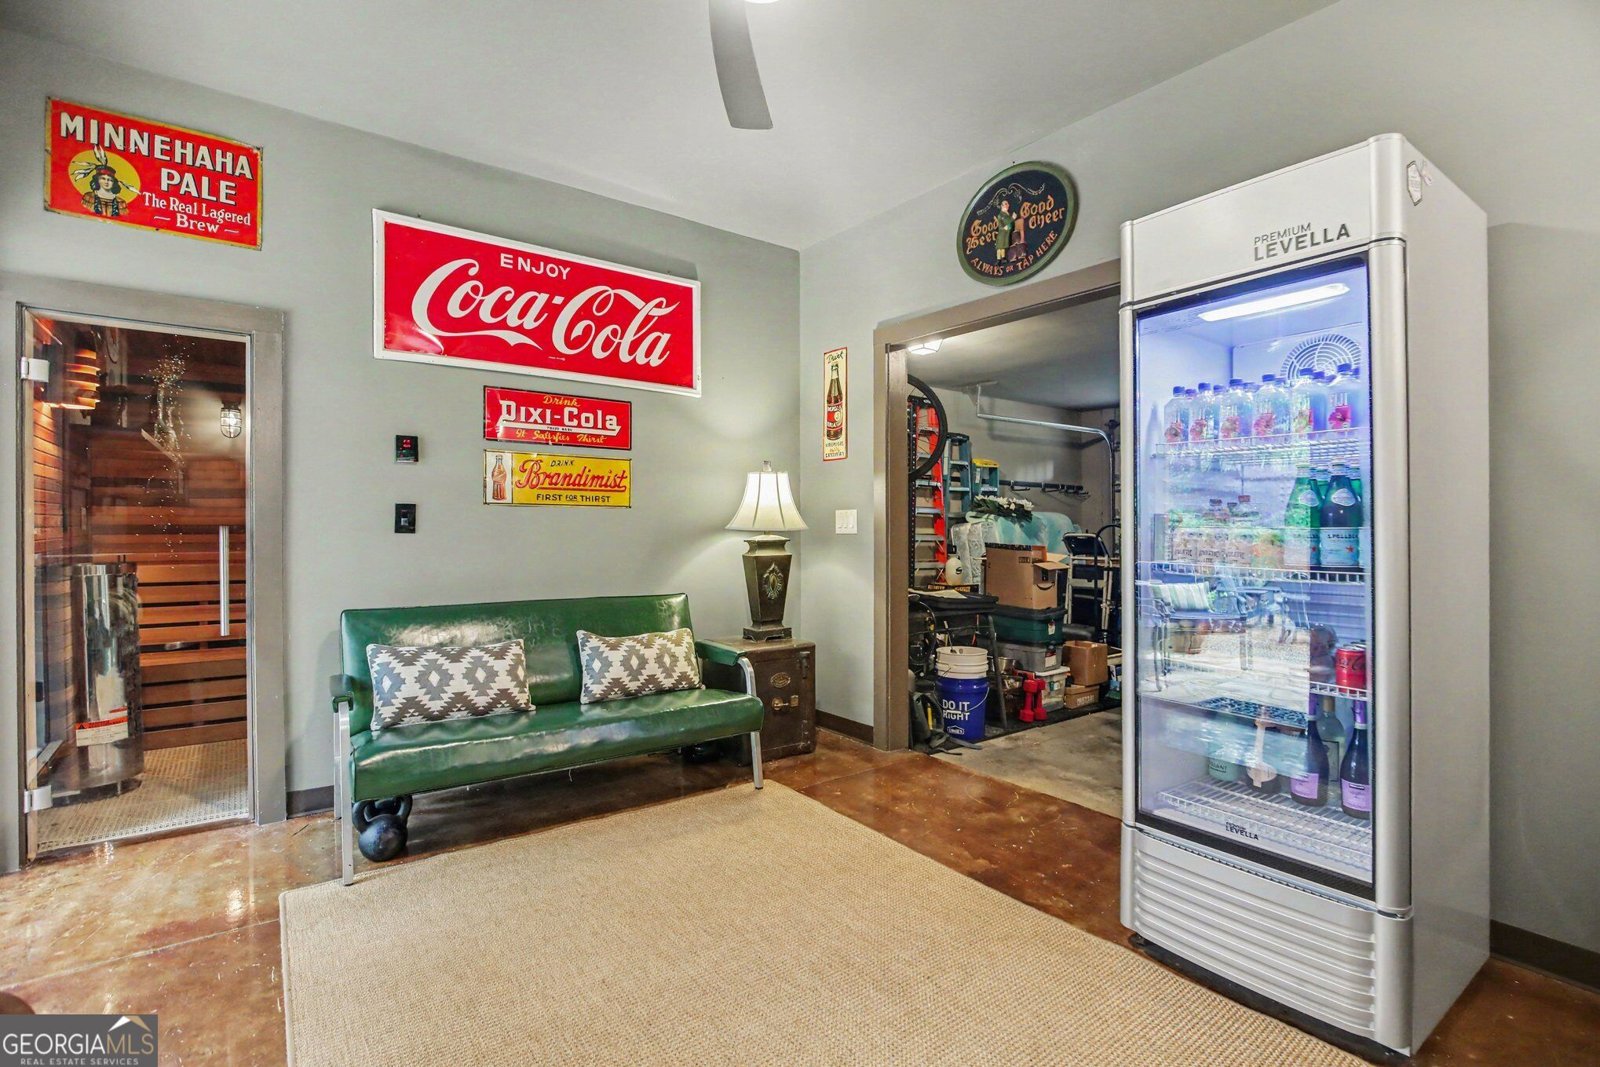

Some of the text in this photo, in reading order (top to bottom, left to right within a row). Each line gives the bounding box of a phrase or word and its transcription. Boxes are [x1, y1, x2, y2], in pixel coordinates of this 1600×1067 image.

[60, 112, 253, 179] MINNEHAHA
[160, 167, 236, 205] PALE
[142, 191, 251, 226] The Real Lagered
[1020, 194, 1055, 219] Good
[176, 213, 219, 234] Brew
[970, 215, 999, 237] Good
[1253, 222, 1312, 246] PREMIUM
[1253, 223, 1350, 262] LEVELLA
[500, 253, 571, 281] ENJOY
[970, 257, 1005, 276] ALWAYS
[1016, 254, 1034, 271] TAP
[411, 258, 680, 367] Coca-Cola
[543, 394, 580, 408] Drink
[576, 433, 608, 444] Thirst
[550, 459, 575, 468] DRINK
[515, 458, 628, 493] Brandimist
[581, 495, 611, 503] THIRST
[942, 699, 971, 712] DO IT
[942, 709, 971, 721] RIGHT
[1225, 824, 1259, 841] LEVELLA
